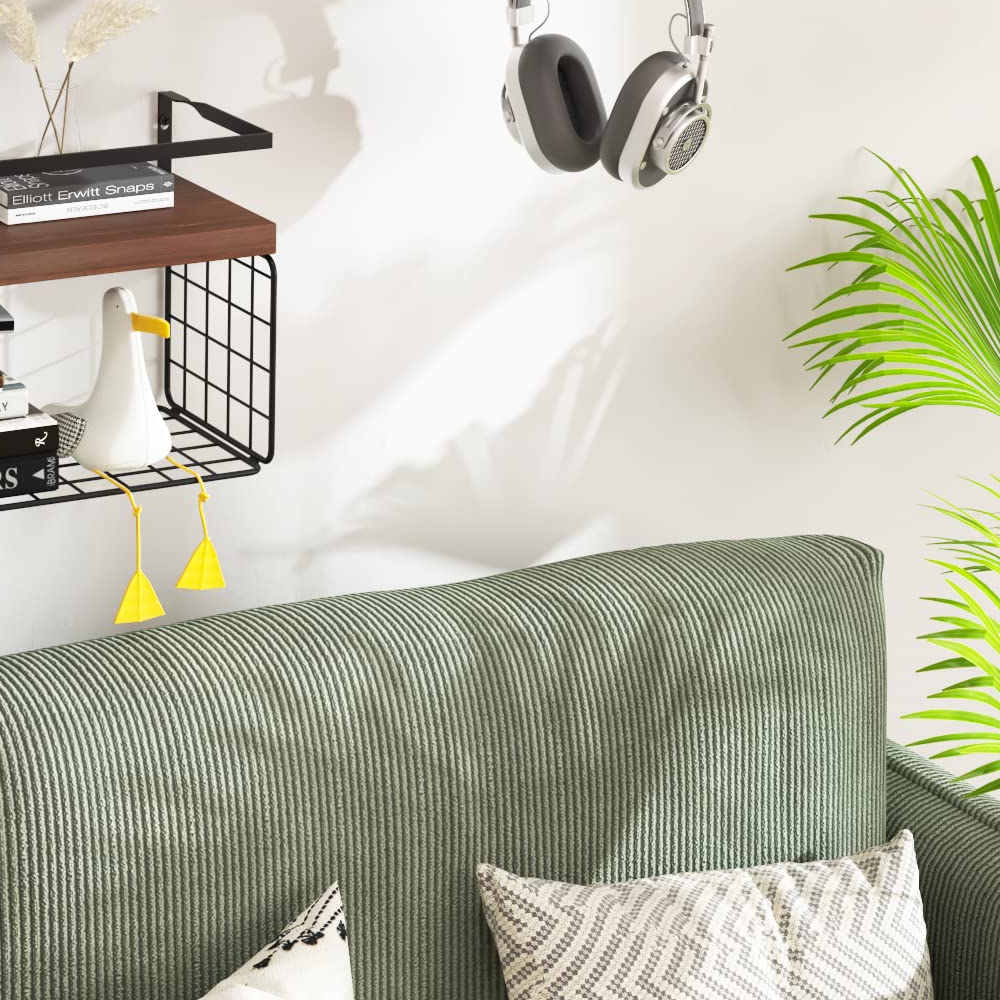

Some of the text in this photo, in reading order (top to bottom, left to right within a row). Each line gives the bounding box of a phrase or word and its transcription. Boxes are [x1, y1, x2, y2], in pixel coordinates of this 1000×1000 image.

[12, 182, 155, 206] Elliott Erwitt Snaps
